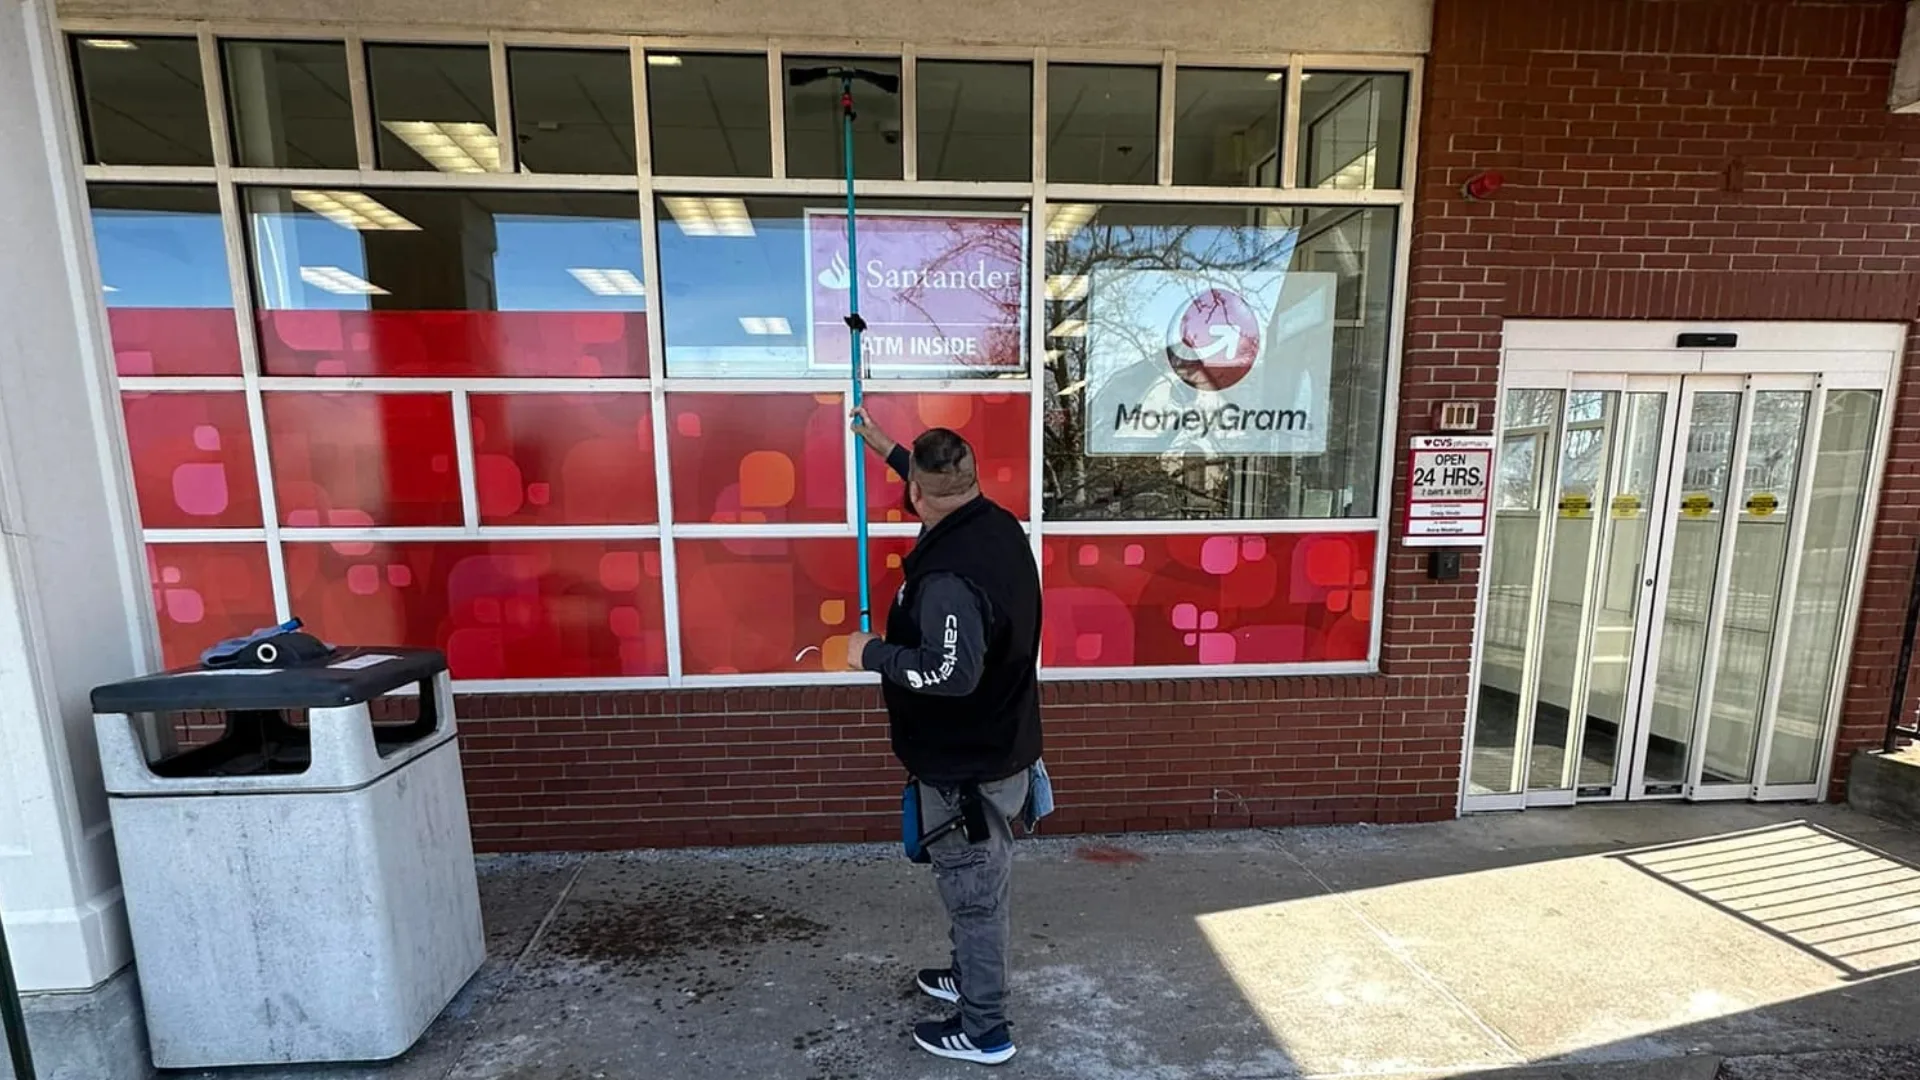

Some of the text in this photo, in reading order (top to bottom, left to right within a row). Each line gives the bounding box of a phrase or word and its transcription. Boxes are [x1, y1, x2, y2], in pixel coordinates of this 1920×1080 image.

[866, 259, 1018, 290] Santander
[861, 336, 977, 356] ATM INSIDE
[1114, 403, 1307, 436] MoneyGram
[1432, 438, 1489, 448] CVS pharmacy
[1435, 454, 1466, 466] OPEN
[1413, 467, 1436, 486] 24
[1427, 488, 1444, 496] DAYS
[1453, 488, 1472, 496] WEEK
